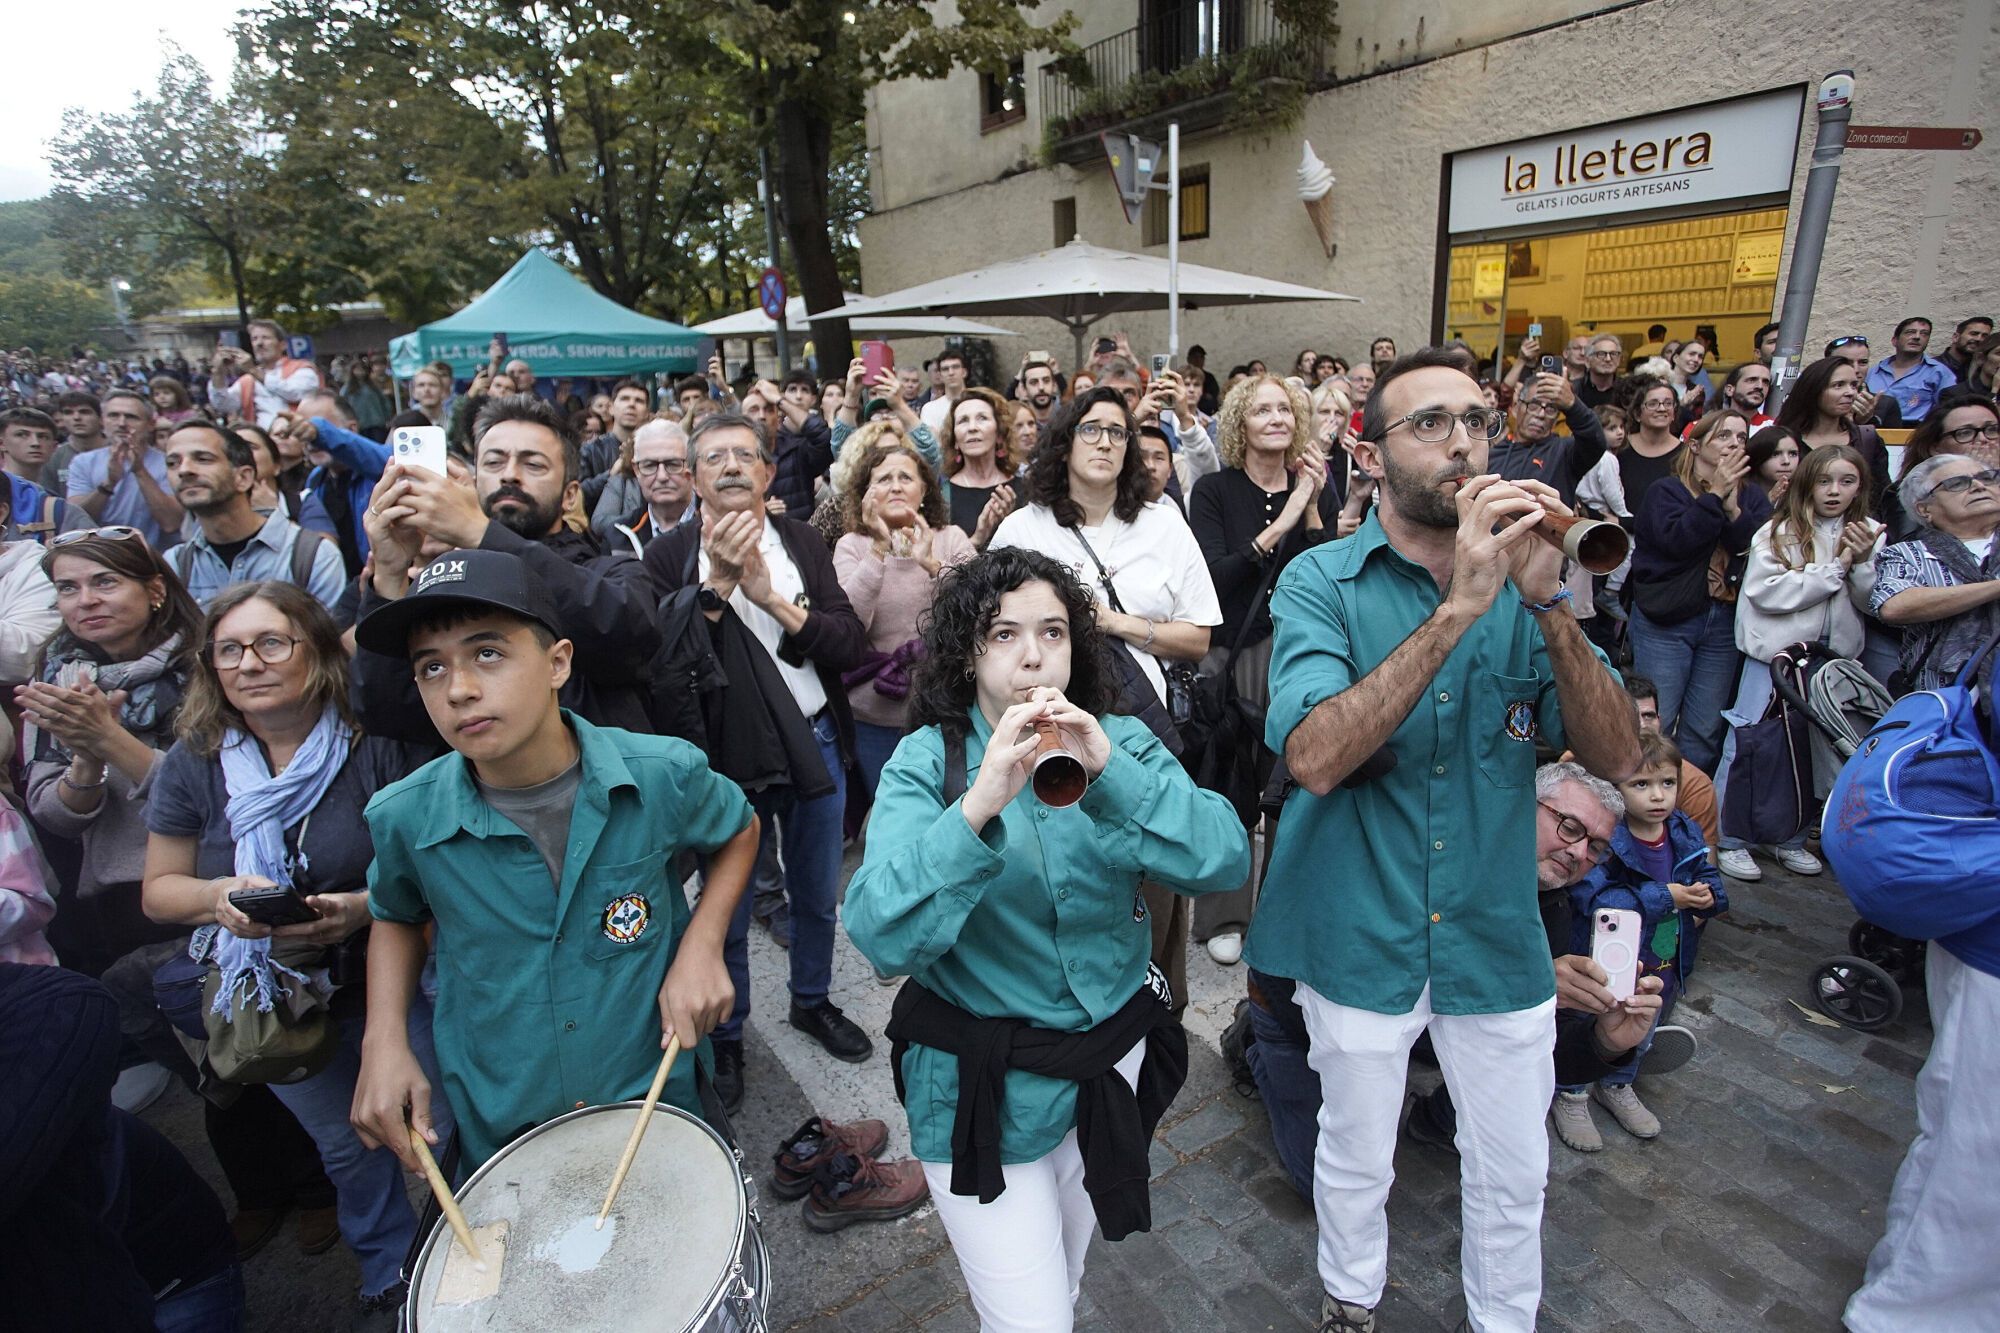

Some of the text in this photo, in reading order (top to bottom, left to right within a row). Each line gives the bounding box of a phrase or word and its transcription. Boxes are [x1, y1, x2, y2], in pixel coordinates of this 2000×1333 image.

[1847, 130, 1909, 144] Zona comercial
[1504, 131, 1713, 194] la lletera
[1516, 196, 1557, 213] GELATS
[1566, 188, 1620, 205] IOGURTS
[1623, 179, 1690, 199] ARTESANS
[291, 337, 307, 358] P
[566, 344, 625, 358] SEMPRE
[419, 560, 464, 585] FOX
